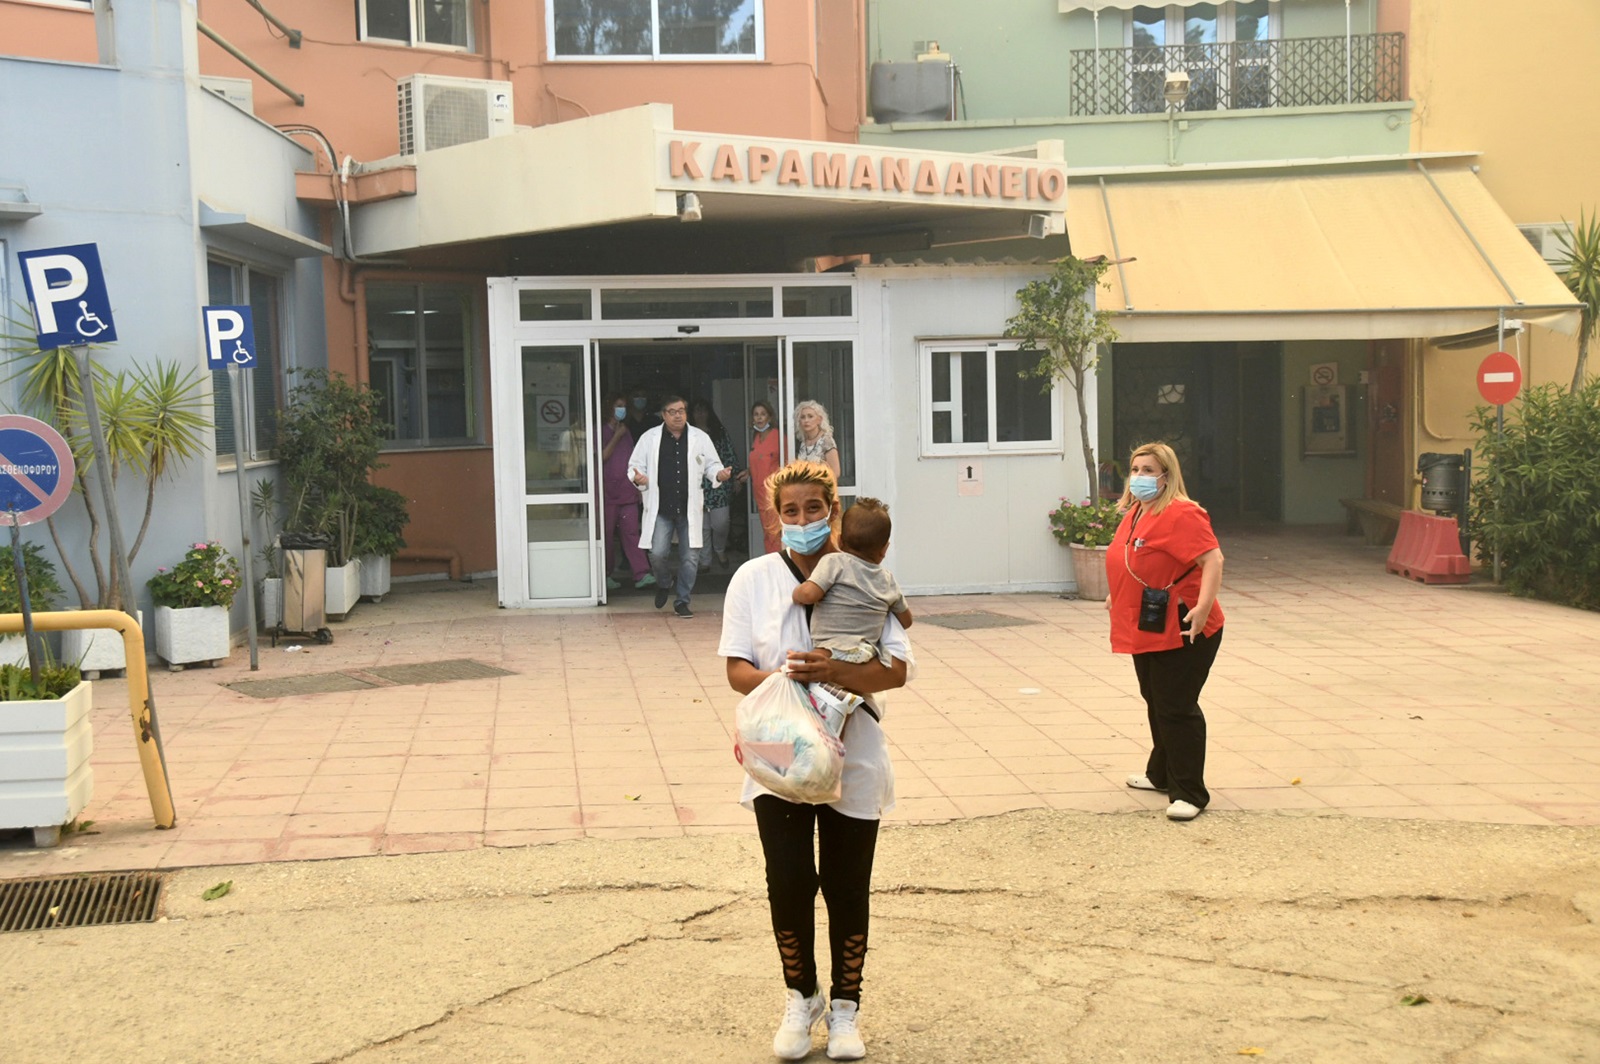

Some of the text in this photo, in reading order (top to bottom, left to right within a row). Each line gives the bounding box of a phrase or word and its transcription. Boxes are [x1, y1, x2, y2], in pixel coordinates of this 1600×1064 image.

[669, 140, 1066, 201] ΚΑΡΑΜΑΝΔΑΝΕΙΟ
[25, 254, 89, 334] P
[206, 310, 244, 360] P
